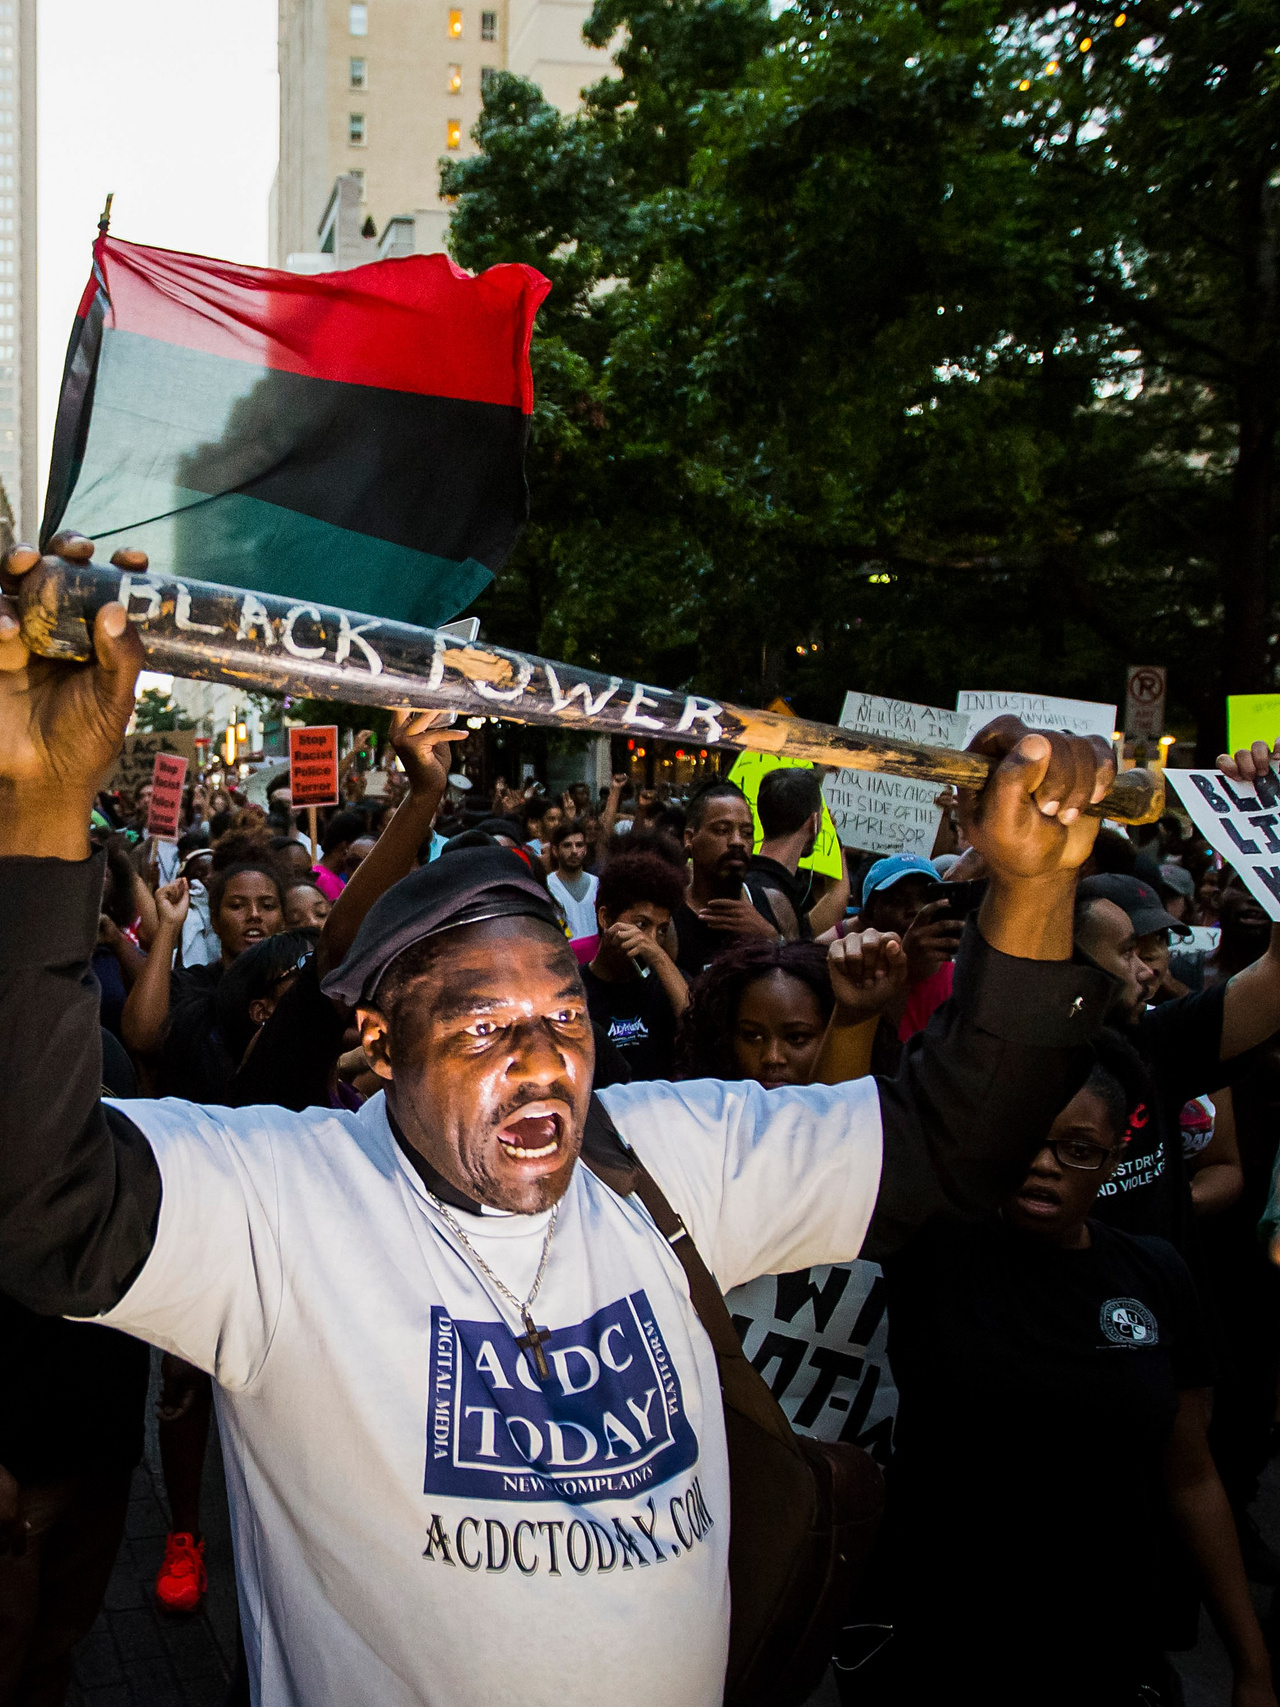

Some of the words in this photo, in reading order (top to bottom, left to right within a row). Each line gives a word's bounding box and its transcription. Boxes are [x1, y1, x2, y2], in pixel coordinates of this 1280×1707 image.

[119, 571, 383, 677] BLACK
[427, 634, 724, 744] POWER
[883, 698, 915, 716] YOU
[921, 707, 959, 727] ARE
[963, 693, 1051, 711] INJUSTICE
[857, 705, 916, 733] NEUTRAL
[928, 723, 950, 741] IN
[1020, 711, 1095, 730] ANYWHERE
[294, 750, 333, 761] Racist
[298, 735, 327, 748] Stop
[294, 766, 331, 778] Police
[834, 769, 862, 789] YOU
[868, 777, 902, 797] HAVE
[904, 785, 939, 804] CHOSE
[827, 788, 853, 807] THE
[858, 795, 892, 814] SIDE
[894, 805, 913, 820] OF
[915, 807, 936, 824] THE
[833, 809, 925, 846] OPPRESSOR
[434, 1316, 453, 1394] DIGITAL
[643, 1320, 679, 1416] PLATFORM
[433, 1399, 450, 1460] MEDIA
[464, 1386, 658, 1465] TODAY
[552, 1464, 654, 1496] COMPLAINTS
[421, 1476, 715, 1577] ACDCTODAY.COM
